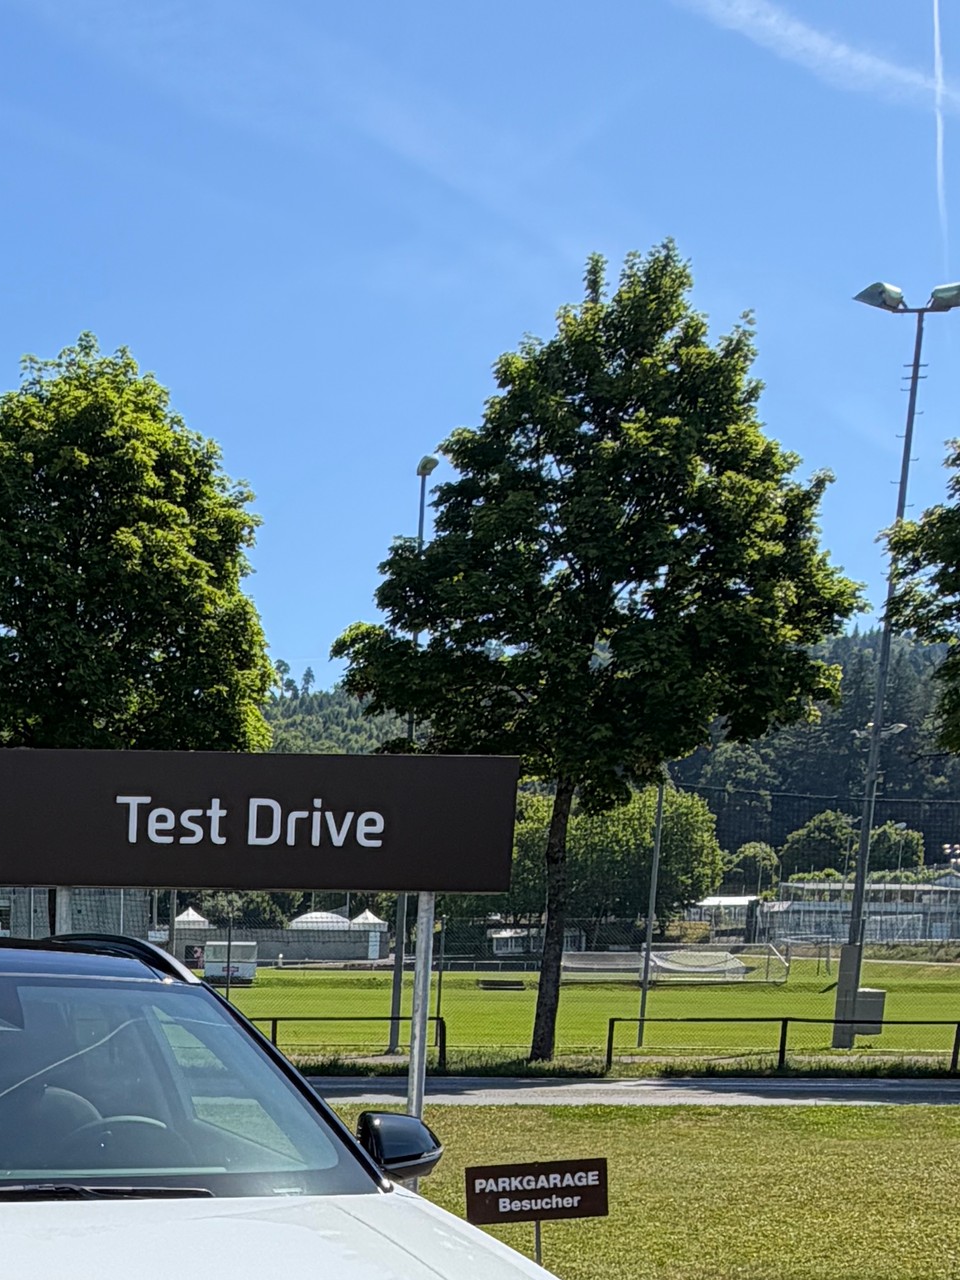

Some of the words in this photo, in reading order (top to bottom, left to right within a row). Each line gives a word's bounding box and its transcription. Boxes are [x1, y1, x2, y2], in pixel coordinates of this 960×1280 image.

[116, 795, 227, 845] Test
[247, 798, 385, 848] Drive
[474, 1171, 600, 1194] PARKGARAGE
[498, 1194, 582, 1212] Besucher
